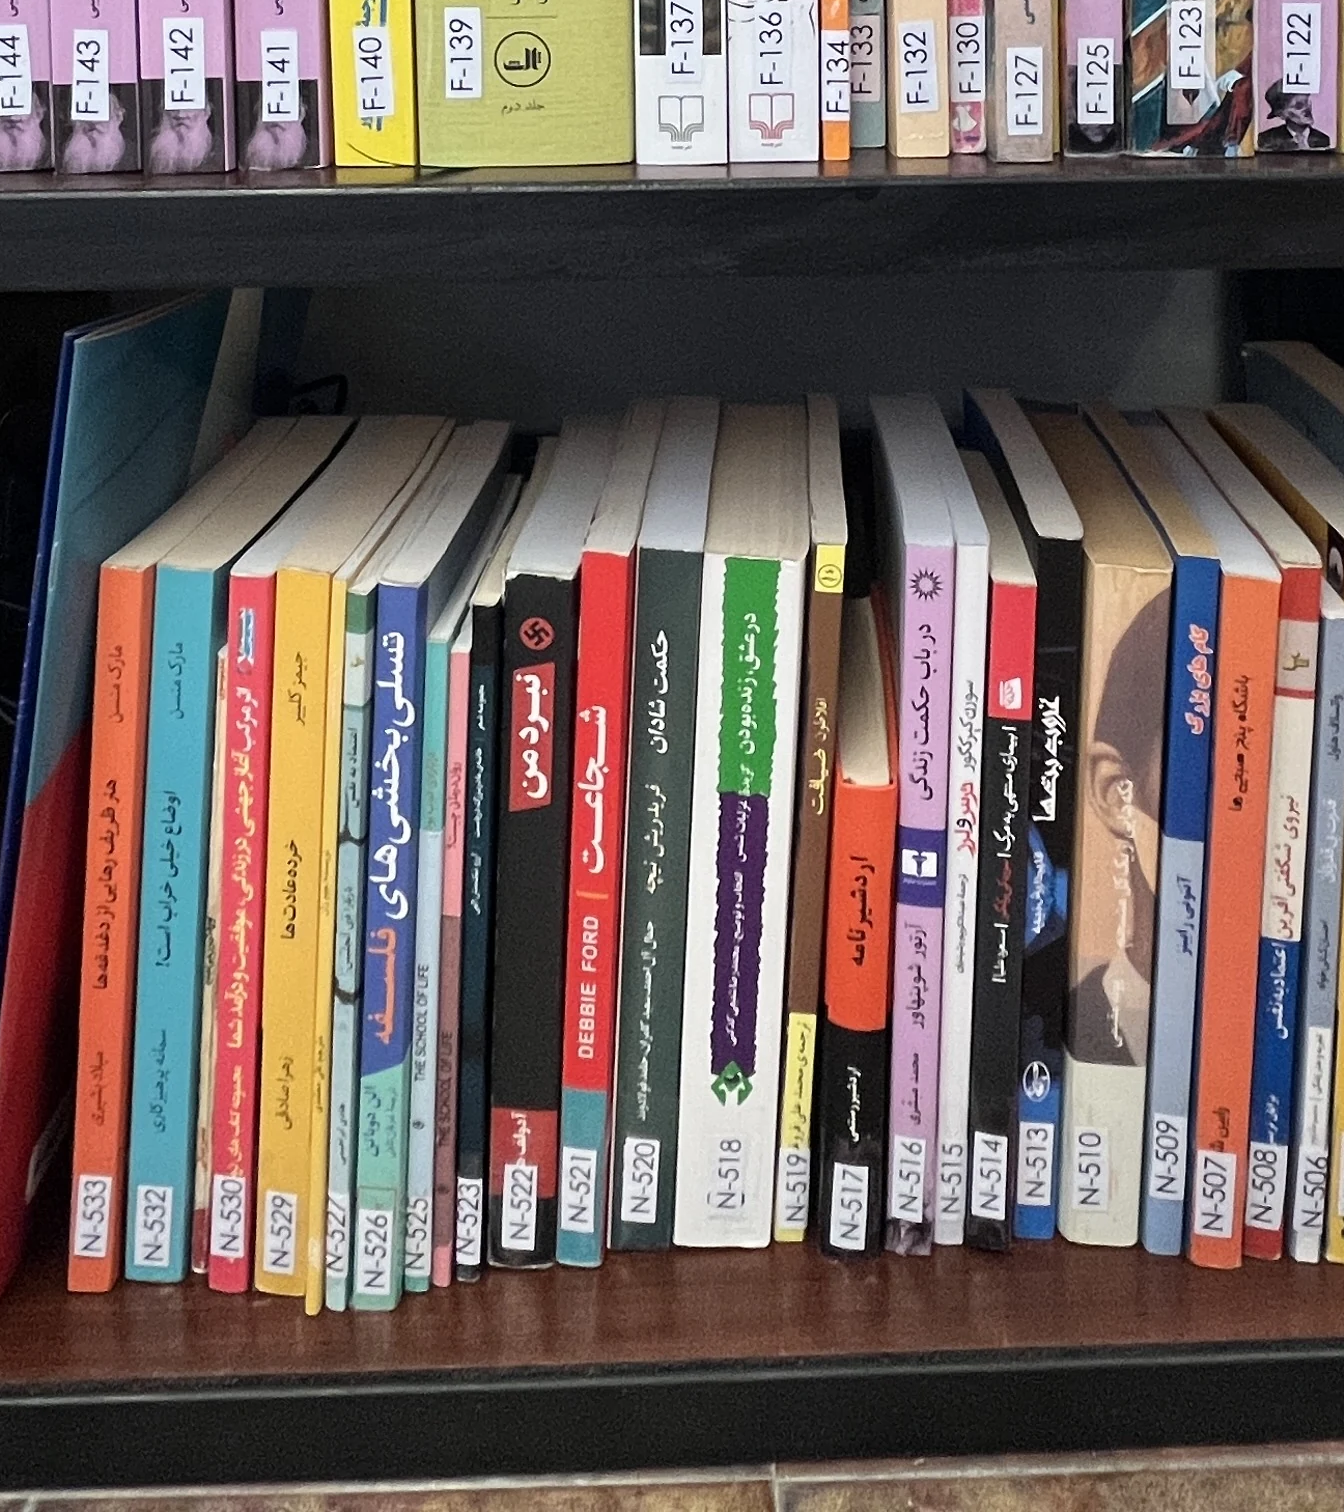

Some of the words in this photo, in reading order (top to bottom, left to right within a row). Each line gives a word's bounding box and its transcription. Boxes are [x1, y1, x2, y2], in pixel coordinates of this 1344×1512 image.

[168, 28, 194, 103] F-142
[358, 36, 384, 112] F-140
[449, 19, 475, 91] F-139
[670, 2, 695, 75] F-137
[760, 12, 784, 84] F-136
[904, 31, 928, 105] F-132
[956, 22, 980, 94] F-130
[1179, 7, 1203, 79] F-123
[1287, 13, 1311, 86] F-122
[74, 40, 100, 114] F-143
[265, 45, 290, 115] F-141
[826, 41, 848, 112] F-134
[1015, 55, 1038, 127] F-127
[1086, 44, 1110, 115] F-125
[649, 631, 669, 694] حکمت
[914, 624, 933, 641] در
[916, 646, 937, 679] باب
[513, 674, 548, 743] نبرد
[647, 699, 669, 754] شادان
[912, 686, 930, 745] حکمت
[520, 750, 549, 799] من
[578, 706, 608, 874] شجاعت
[910, 751, 935, 801] زندگی
[581, 916, 599, 972] FORD
[577, 983, 595, 1059] DEBBIE
[567, 1156, 590, 1223] N-521
[630, 1143, 654, 1214] N-520
[718, 1140, 741, 1209] N-518
[787, 1154, 808, 1221] N-519
[896, 1142, 921, 1213] N-516
[939, 1144, 963, 1214] N-515
[979, 1140, 1003, 1211] N-514
[1025, 1128, 1049, 1198] N-513
[1078, 1133, 1102, 1206] N-510
[1155, 1120, 1180, 1193] N-509
[1252, 1150, 1277, 1223] N-508
[1302, 1156, 1326, 1228] N-506
[82, 1181, 107, 1252] N-533
[142, 1189, 166, 1262] N-532
[220, 1180, 242, 1252] N-530
[509, 1169, 533, 1241] N-522
[839, 1170, 863, 1240] N-517
[1202, 1157, 1228, 1231] N-507
[270, 1196, 292, 1268] N-529
[363, 1216, 387, 1288] N-526
